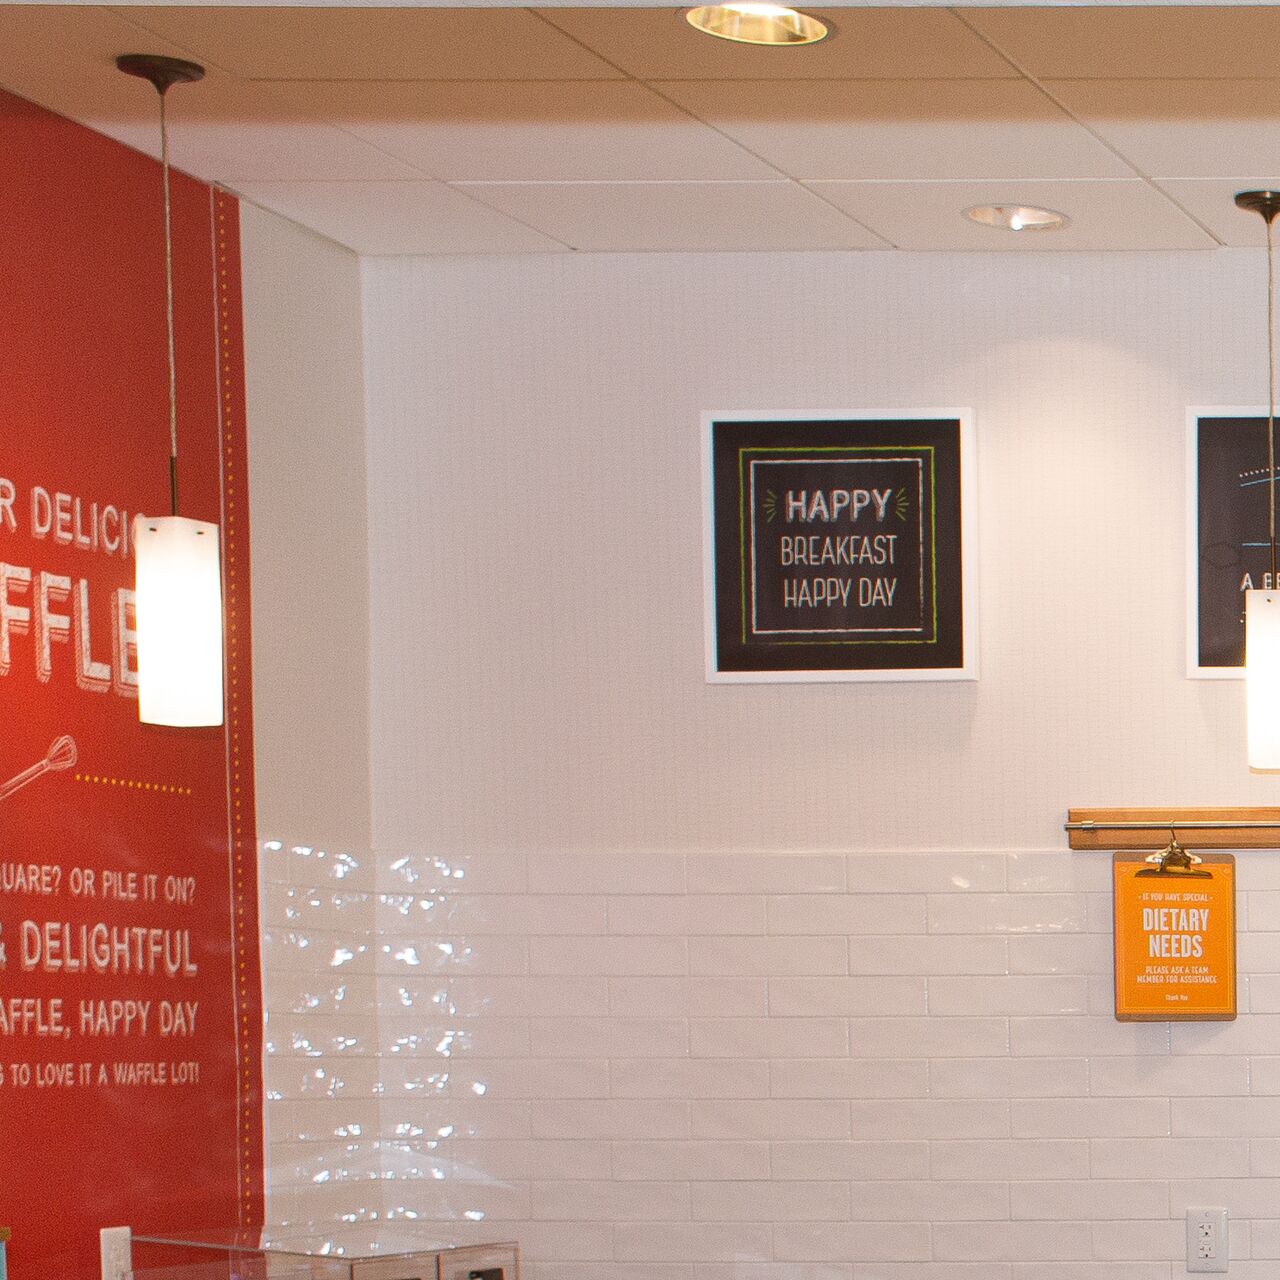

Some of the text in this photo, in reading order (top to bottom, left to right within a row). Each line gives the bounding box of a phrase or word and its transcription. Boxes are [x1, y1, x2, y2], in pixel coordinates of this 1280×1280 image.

[786, 488, 892, 522] HAPPY
[31, 486, 146, 560] DELICI
[781, 535, 898, 566] BREAKFAST
[784, 577, 897, 608] HAPPY DAY
[1240, 572, 1254, 592] A
[0, 863, 196, 905] UARE? OR PILE IT ON?
[1183, 893, 1208, 902] SPECIAL
[1143, 908, 1210, 931] DIETARY
[20, 919, 199, 978] DELIGHTFUL
[1149, 934, 1203, 958] NEEDS
[1136, 975, 1217, 983] MEMBER FOR ASSISTANCE
[1146, 966, 1169, 974] PLEASE
[1185, 966, 1191, 974] A
[1191, 966, 1209, 974] TEAM
[0, 997, 199, 1039] AFFLE, HAPPY DAY
[11, 1063, 32, 1087] TO
[36, 1062, 74, 1088] LOVE
[79, 1063, 93, 1087] IT
[99, 1063, 108, 1087] A
[113, 1062, 167, 1085] WAFFLE
[171, 1062, 199, 1085] LOT!
